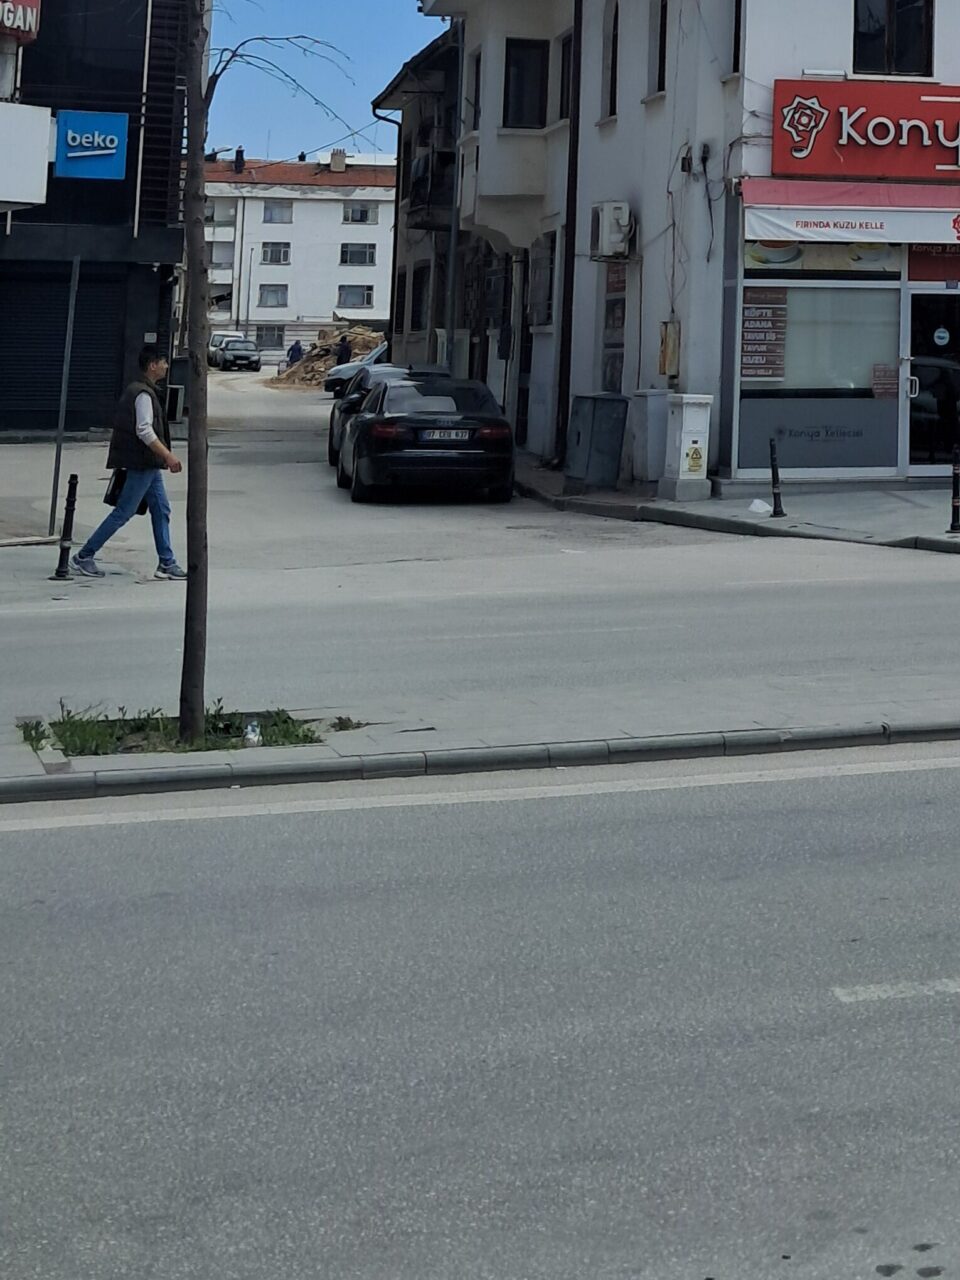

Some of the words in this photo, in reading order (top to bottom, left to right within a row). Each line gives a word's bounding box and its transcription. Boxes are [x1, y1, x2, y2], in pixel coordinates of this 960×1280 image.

[67, 129, 119, 149] beko
[795, 221, 831, 229] FIRINDA
[833, 222, 857, 230] KUZU
[859, 222, 885, 230] KELLE
